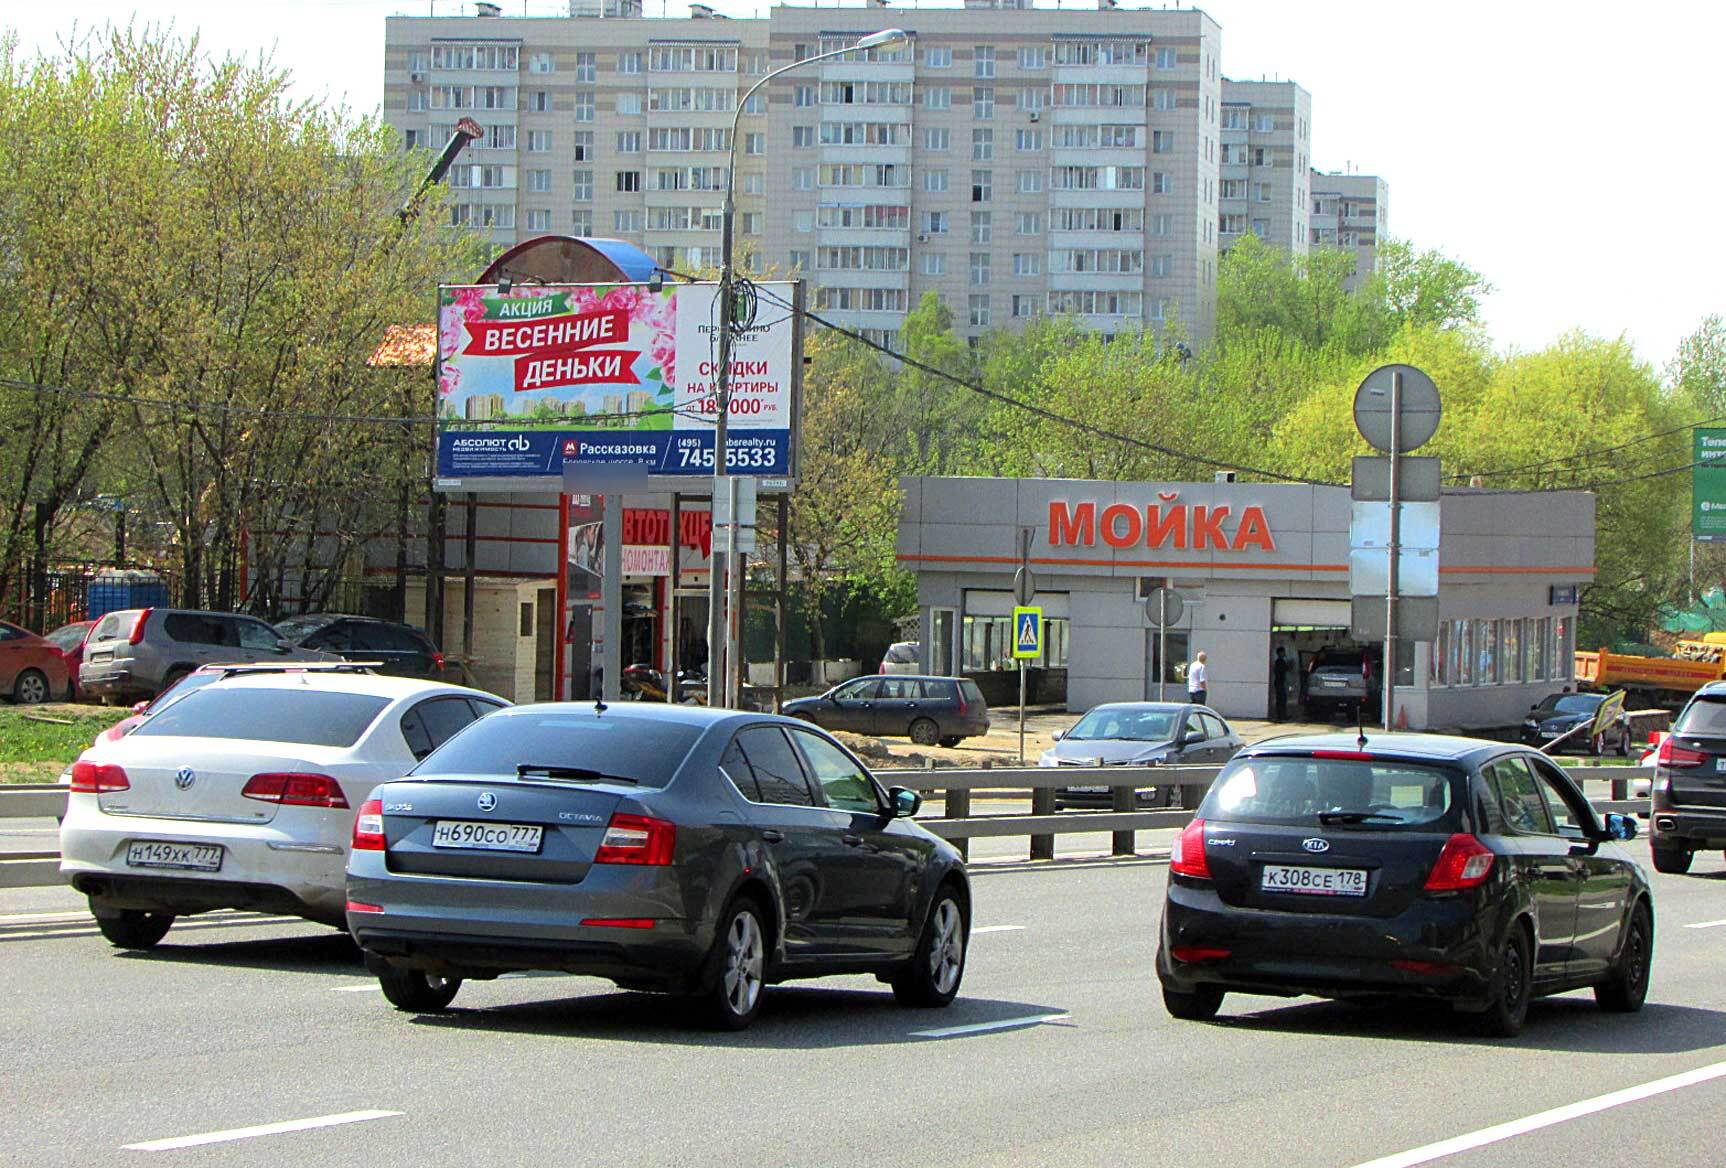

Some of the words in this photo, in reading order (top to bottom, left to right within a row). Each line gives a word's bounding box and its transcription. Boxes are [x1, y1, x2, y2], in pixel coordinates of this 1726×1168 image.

[499, 297, 553, 318] АКЦИЯ
[484, 314, 615, 351] ВЕСЕННИЕ
[522, 356, 622, 388] ДЕНЬКИ
[687, 383, 705, 393] НА
[453, 439, 507, 447] АБСОЛЮТ
[580, 442, 656, 455] Рассказовка
[678, 438, 701, 448] (495)
[678, 448, 714, 468] 745
[726, 448, 776, 467] 5533
[1048, 490, 1276, 551] МОЙКА
[512, 826, 539, 841] 777
[1306, 840, 1325, 850] KIA
[194, 847, 217, 860] 777
[1338, 871, 1362, 885] 178
